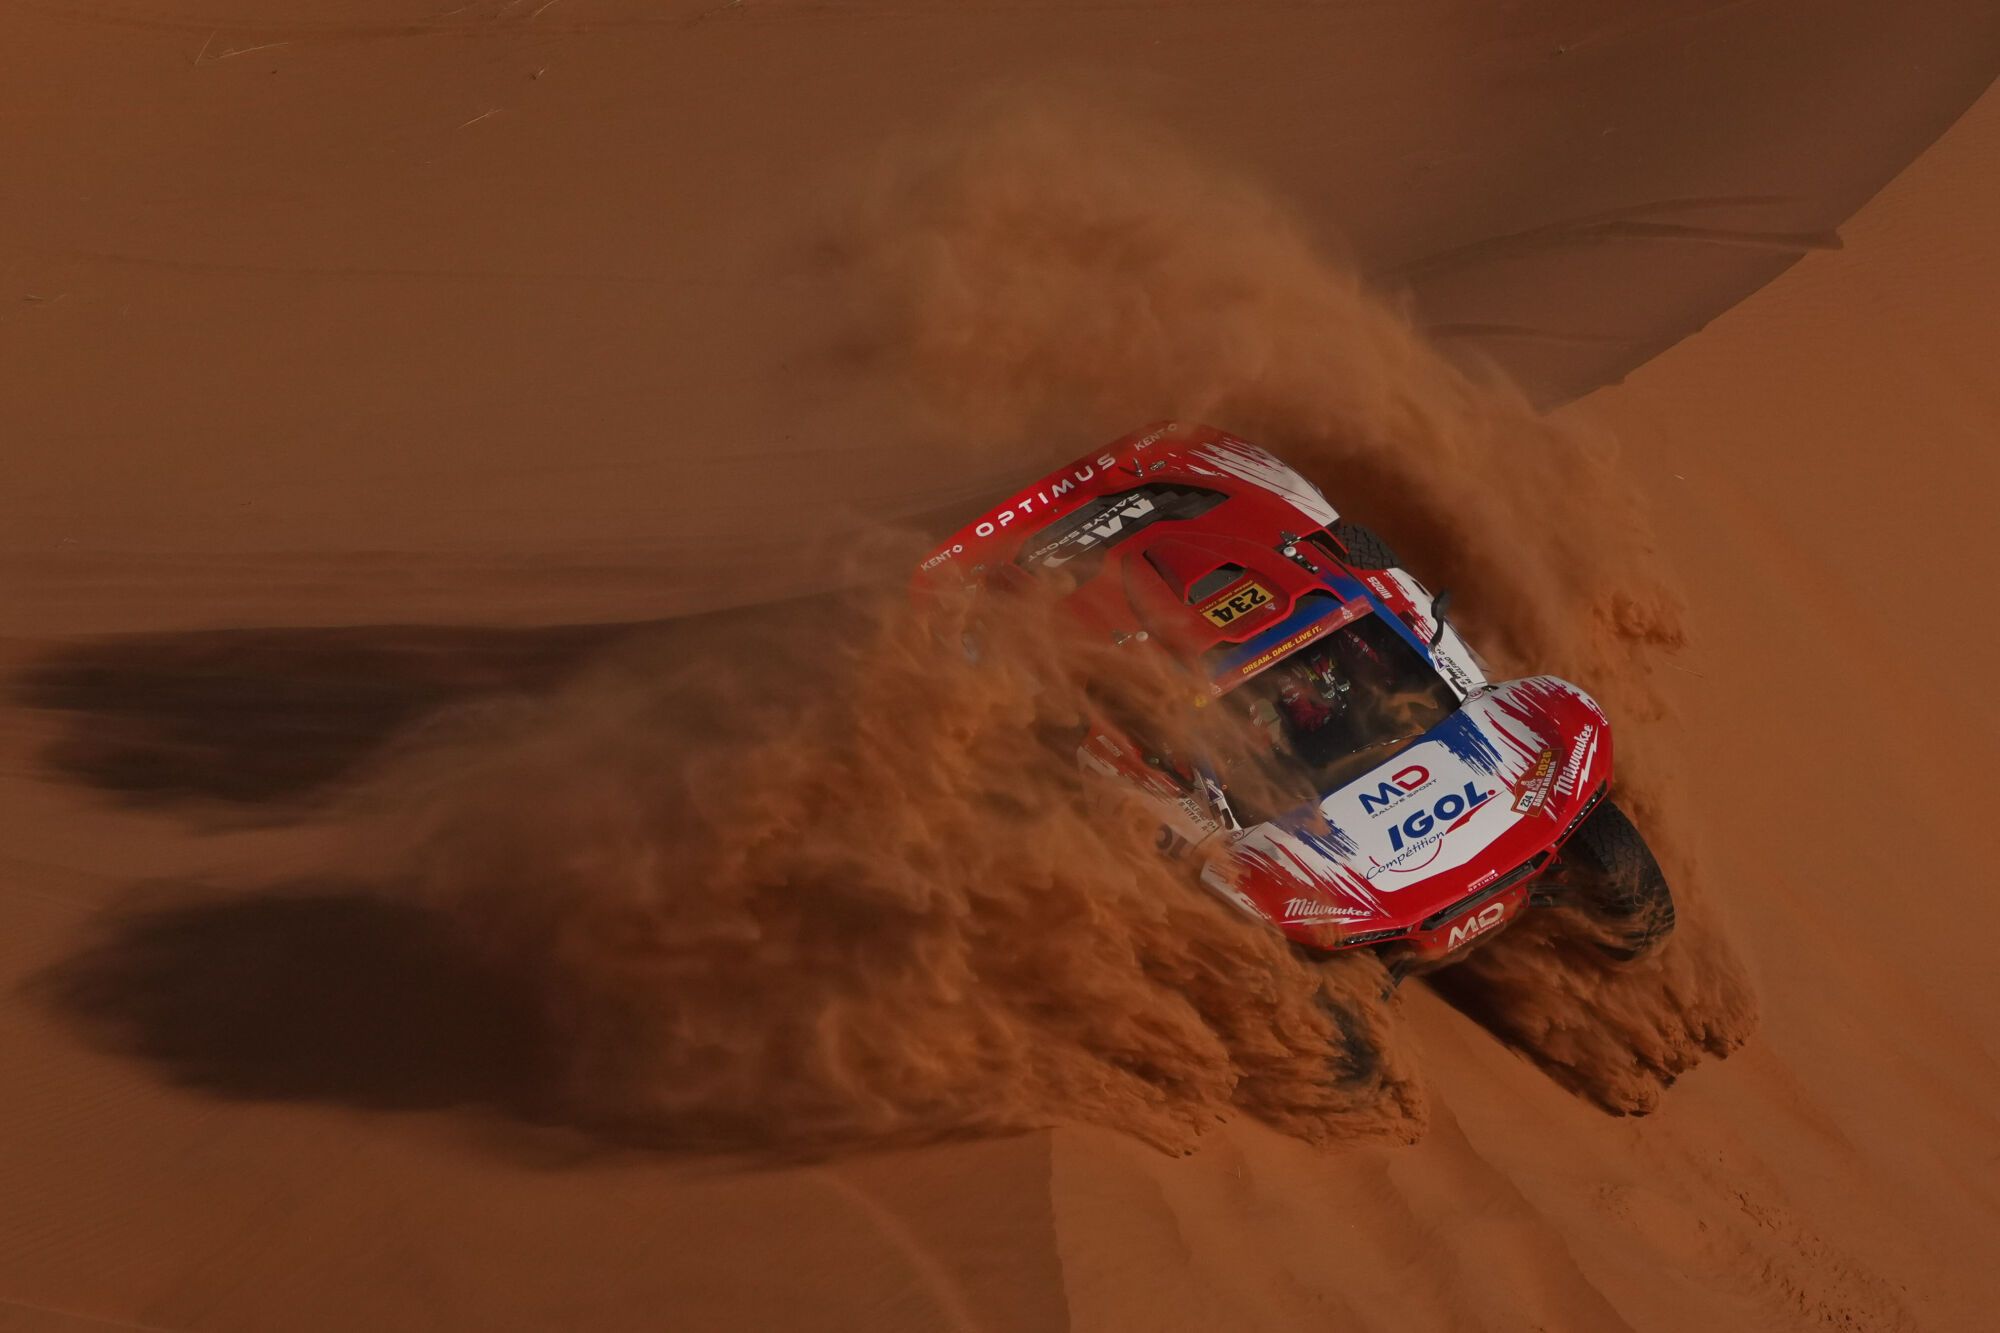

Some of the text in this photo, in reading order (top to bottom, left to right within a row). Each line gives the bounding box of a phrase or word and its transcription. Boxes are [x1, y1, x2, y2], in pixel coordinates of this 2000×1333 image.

[975, 453, 1117, 538] OPTIMUS
[1028, 493, 1140, 562] RALLYE SPORT
[1211, 587, 1266, 622] 234
[1242, 654, 1272, 675] DREAM.
[1272, 641, 1295, 657] DARE.
[1295, 630, 1312, 644] LIVE
[1554, 723, 1594, 797] Milwaukee
[1358, 765, 1430, 815] MD
[1371, 779, 1437, 818] RALLYE SPORT
[1520, 795, 1533, 807] 234
[1532, 788, 1547, 806] SAUDI
[1366, 831, 1445, 880] Compétition
[1467, 873, 1499, 892] OPTIMUS
[1282, 897, 1372, 918] Milwaukee
[1447, 902, 1505, 949] MD
